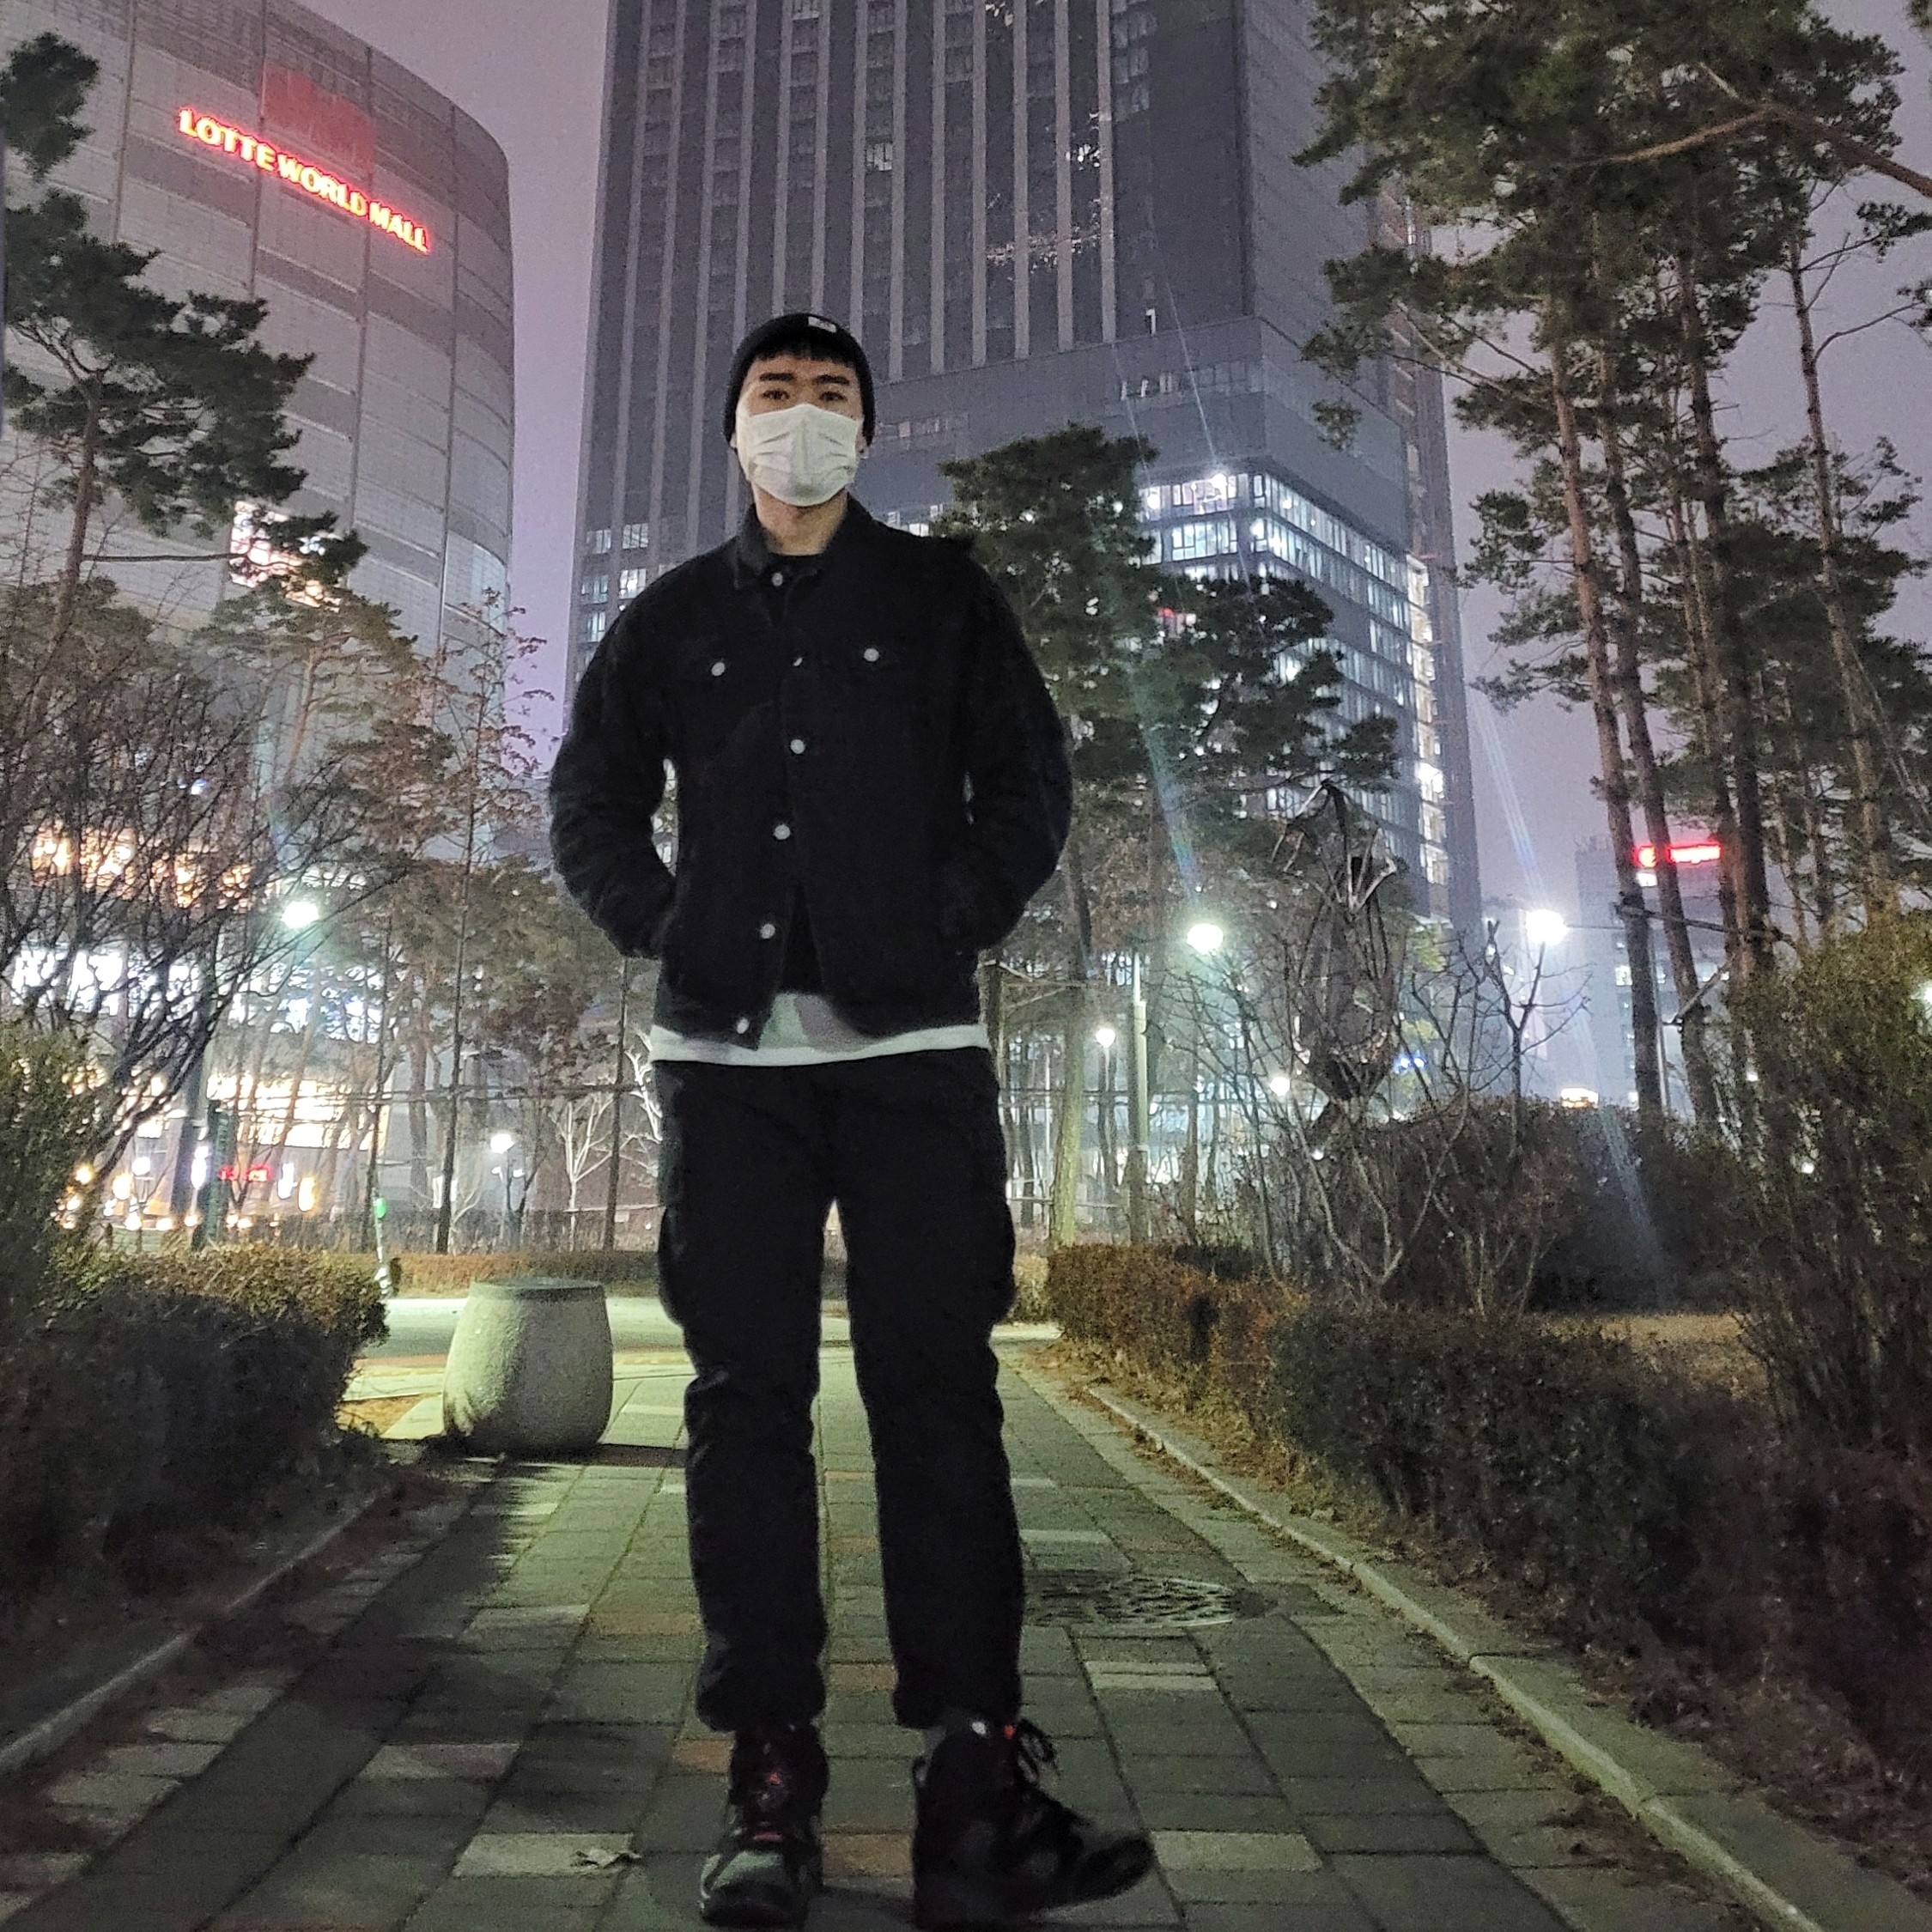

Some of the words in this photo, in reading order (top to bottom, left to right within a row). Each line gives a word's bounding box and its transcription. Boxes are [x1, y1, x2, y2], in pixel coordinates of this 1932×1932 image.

[179, 108, 276, 172] LOTTE
[276, 153, 368, 217] WORLD
[368, 201, 428, 253] MALL
